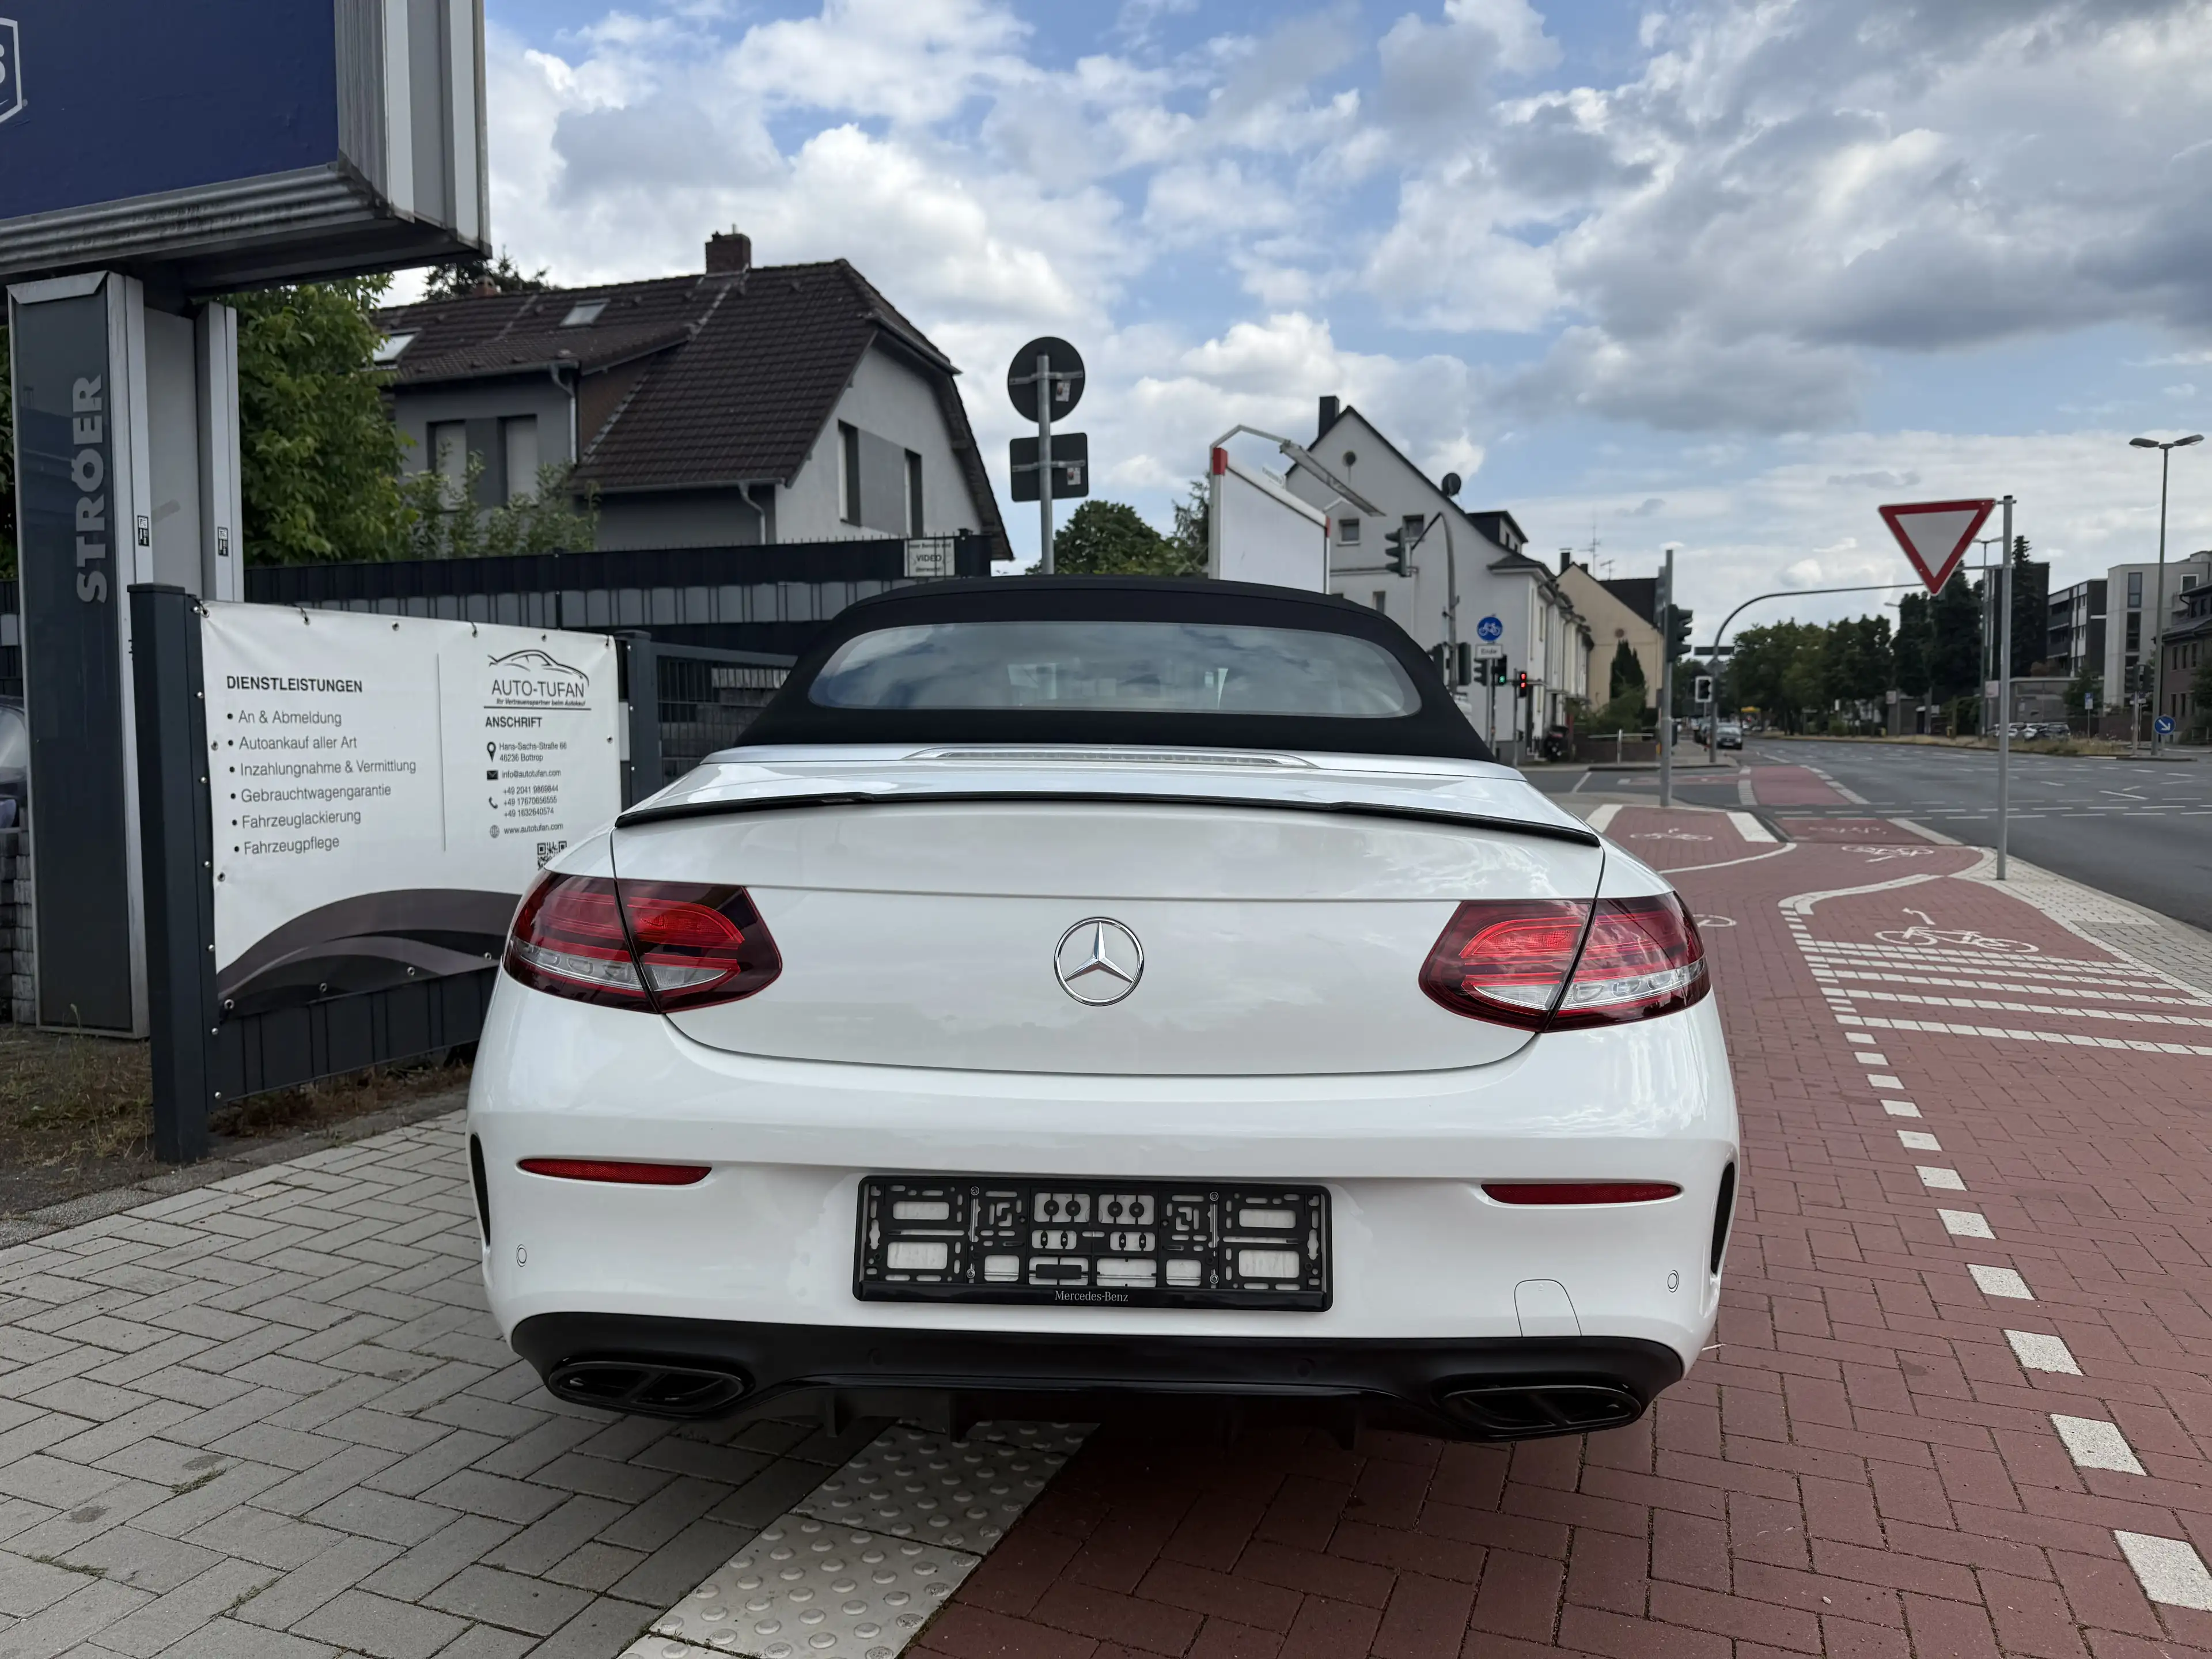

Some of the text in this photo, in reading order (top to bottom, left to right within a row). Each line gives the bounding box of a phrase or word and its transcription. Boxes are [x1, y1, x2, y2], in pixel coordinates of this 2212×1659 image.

[71, 374, 108, 603] STRÖER
[227, 676, 363, 693] DIENSTLEISTUNGEN
[491, 679, 585, 698] AUTO-TUFAN
[238, 710, 343, 728] An & Abmeldung
[485, 716, 543, 728] ANSCHRIFT
[238, 736, 358, 750] Autoankauf aller Art
[499, 741, 559, 751] Hans-Sachs-Straße
[499, 753, 544, 763] 46236 Bottrop
[240, 759, 416, 778] Inzahlungnahme & Vermittlung
[502, 769, 562, 779] info@autotufan.com
[241, 784, 391, 802] Gebrauchtwagengarantie
[503, 786, 515, 795] +49
[516, 786, 531, 795] 2041
[503, 798, 516, 806] +49
[242, 810, 361, 830] Fahrzeuglackierung
[504, 809, 516, 818] +49
[503, 823, 564, 835] www.autotufan.com
[244, 836, 340, 855] Fahrzeugpflege
[1055, 1290, 1128, 1302] Mercedes-Benz
